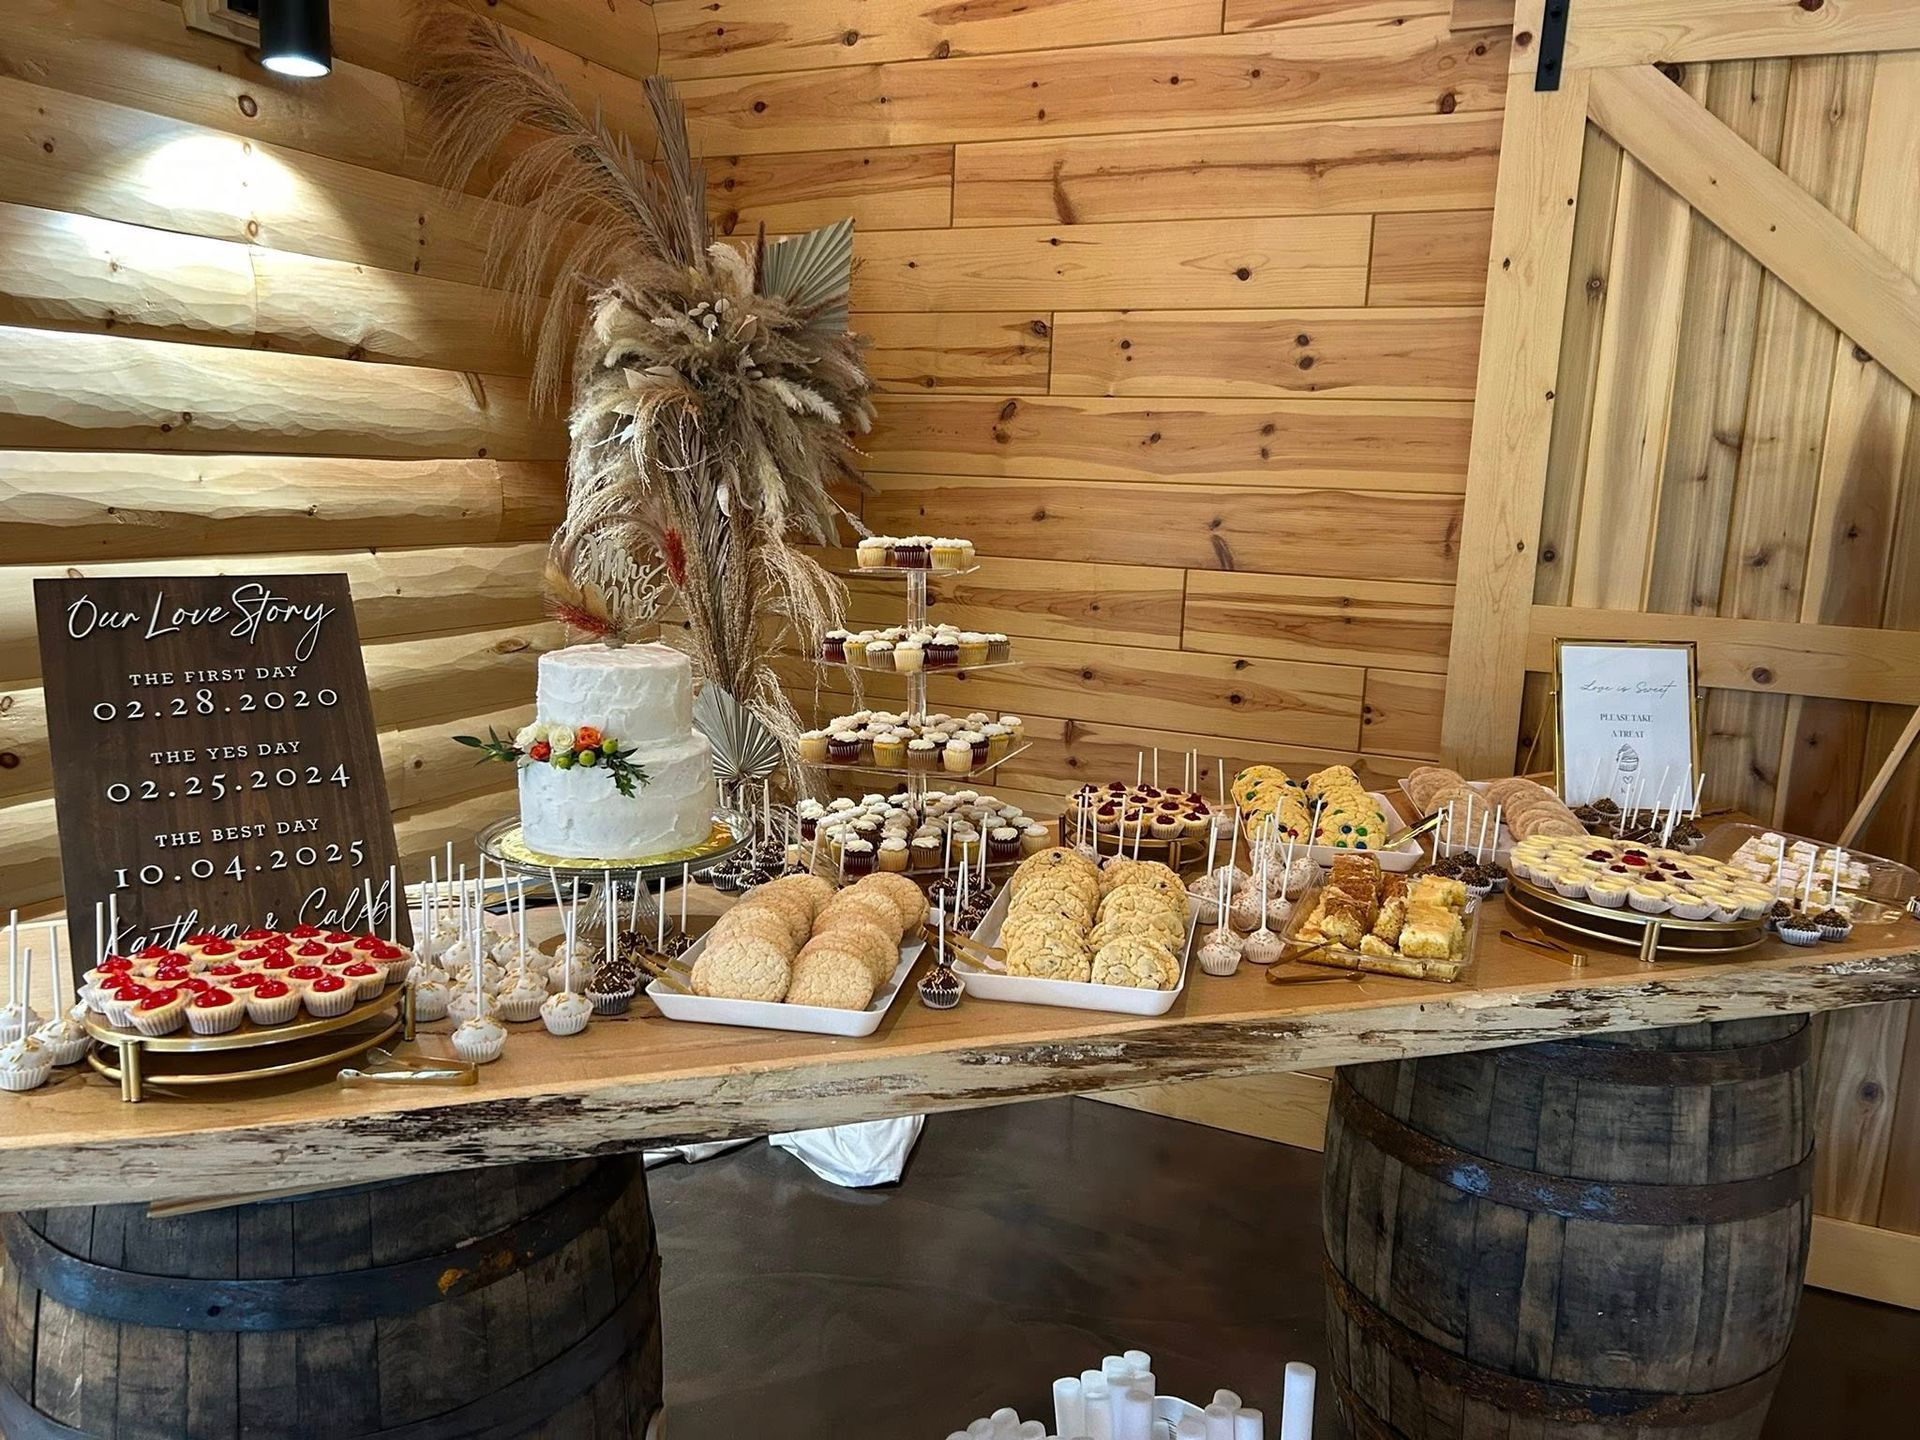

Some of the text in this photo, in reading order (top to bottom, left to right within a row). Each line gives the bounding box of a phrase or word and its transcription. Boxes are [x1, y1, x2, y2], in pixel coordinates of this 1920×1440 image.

[67, 583, 335, 661] Our Love Story
[129, 665, 298, 687] THE FIRST DAY
[1579, 680, 1677, 699] Love is Sweet
[93, 688, 338, 721] 02.28.2020
[1600, 713, 1653, 723] PLEASE TAKE
[1611, 730, 1644, 738] A TREAT
[150, 741, 300, 765] THE YES DAY
[107, 763, 350, 803] 02.25.2024
[155, 818, 319, 847] THE BEST DAY
[114, 839, 364, 889] 10.04.2025
[264, 912, 279, 930] &
[299, 879, 391, 933] Caleb
